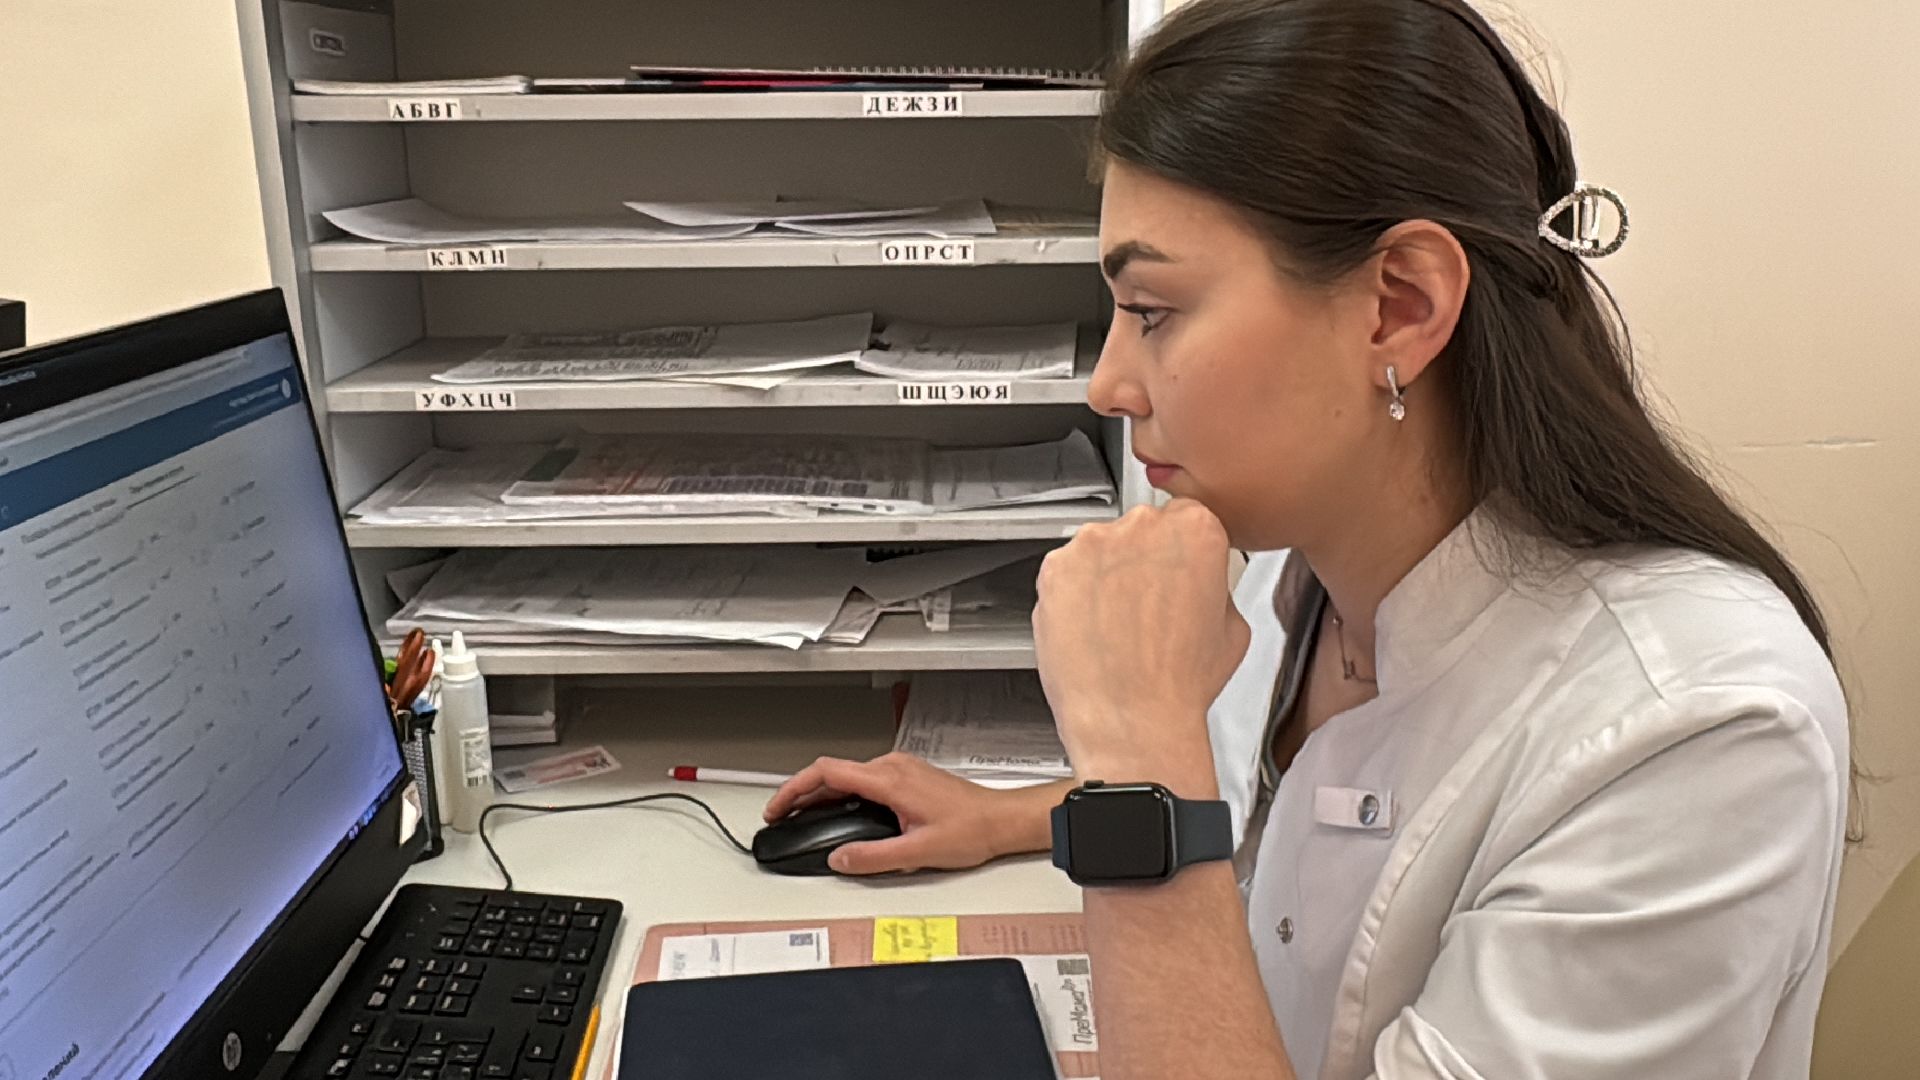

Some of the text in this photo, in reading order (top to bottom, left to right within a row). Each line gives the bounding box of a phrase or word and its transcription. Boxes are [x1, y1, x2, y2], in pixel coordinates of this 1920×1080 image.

[392, 102, 458, 119] АБВГ
[867, 96, 957, 115] ДЕЖЗИ
[431, 249, 504, 266] КЛМН
[885, 244, 971, 261] ОПРСТ
[422, 392, 512, 409] УФХЦЧ
[902, 384, 1008, 401] ШЩЭЮЯ
